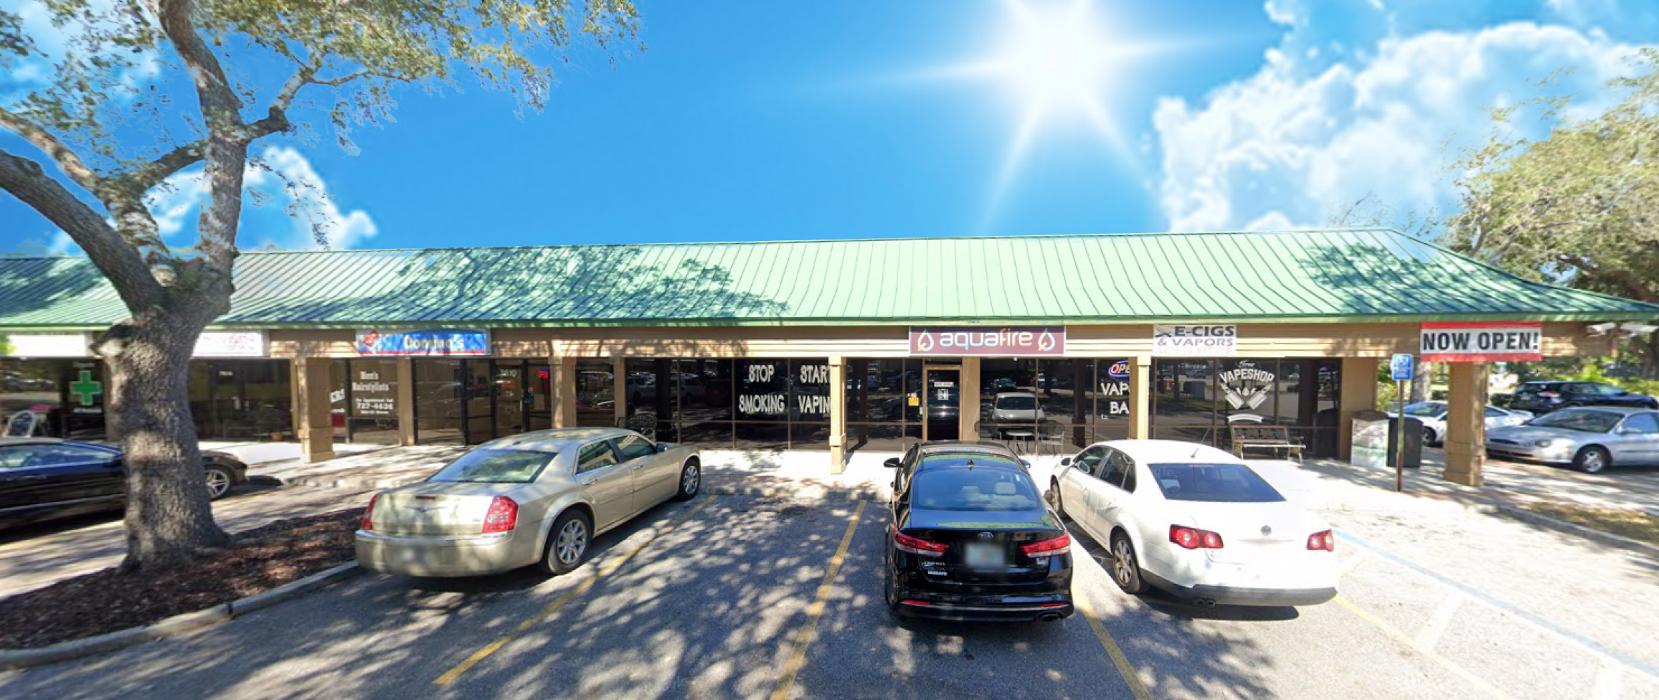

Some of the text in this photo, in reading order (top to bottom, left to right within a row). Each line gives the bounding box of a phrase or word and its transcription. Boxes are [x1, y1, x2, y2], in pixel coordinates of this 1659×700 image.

[939, 328, 1034, 350] aquafire
[1174, 326, 1235, 337] E-CIGS
[1157, 338, 1234, 347] & VAPORS
[1423, 332, 1539, 350] NOW OPEN!
[749, 364, 775, 382] STOP
[1110, 363, 1130, 374] OPE
[1219, 368, 1275, 383] VAPESHOP
[1100, 381, 1130, 396] VAP
[739, 394, 785, 414] SMOKING
[798, 395, 831, 414] VAPIN
[1109, 401, 1130, 415] BA
